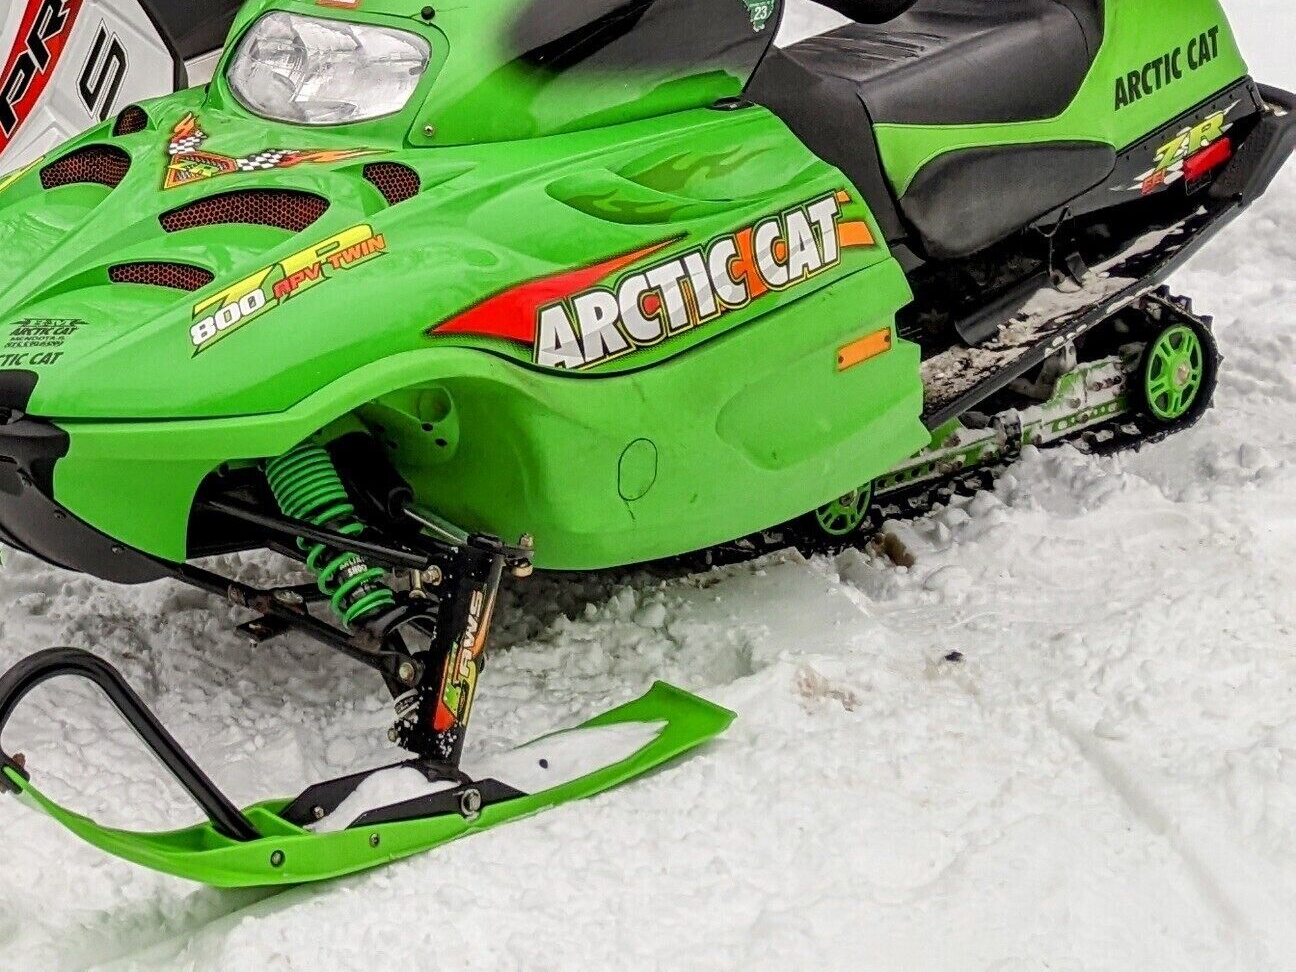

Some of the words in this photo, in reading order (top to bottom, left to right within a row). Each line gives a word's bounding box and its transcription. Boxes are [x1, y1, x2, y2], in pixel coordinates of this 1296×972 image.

[753, 5, 768, 20] 23
[1114, 46, 1183, 112] ARCTIC
[1187, 24, 1219, 70] CAT
[1154, 112, 1225, 172] ZR
[189, 288, 267, 347] 800
[272, 262, 322, 298] APV
[326, 233, 386, 270] TWIN
[533, 233, 752, 370] ARCTIC
[750, 190, 843, 292] CAT
[29, 351, 65, 366] CAT
